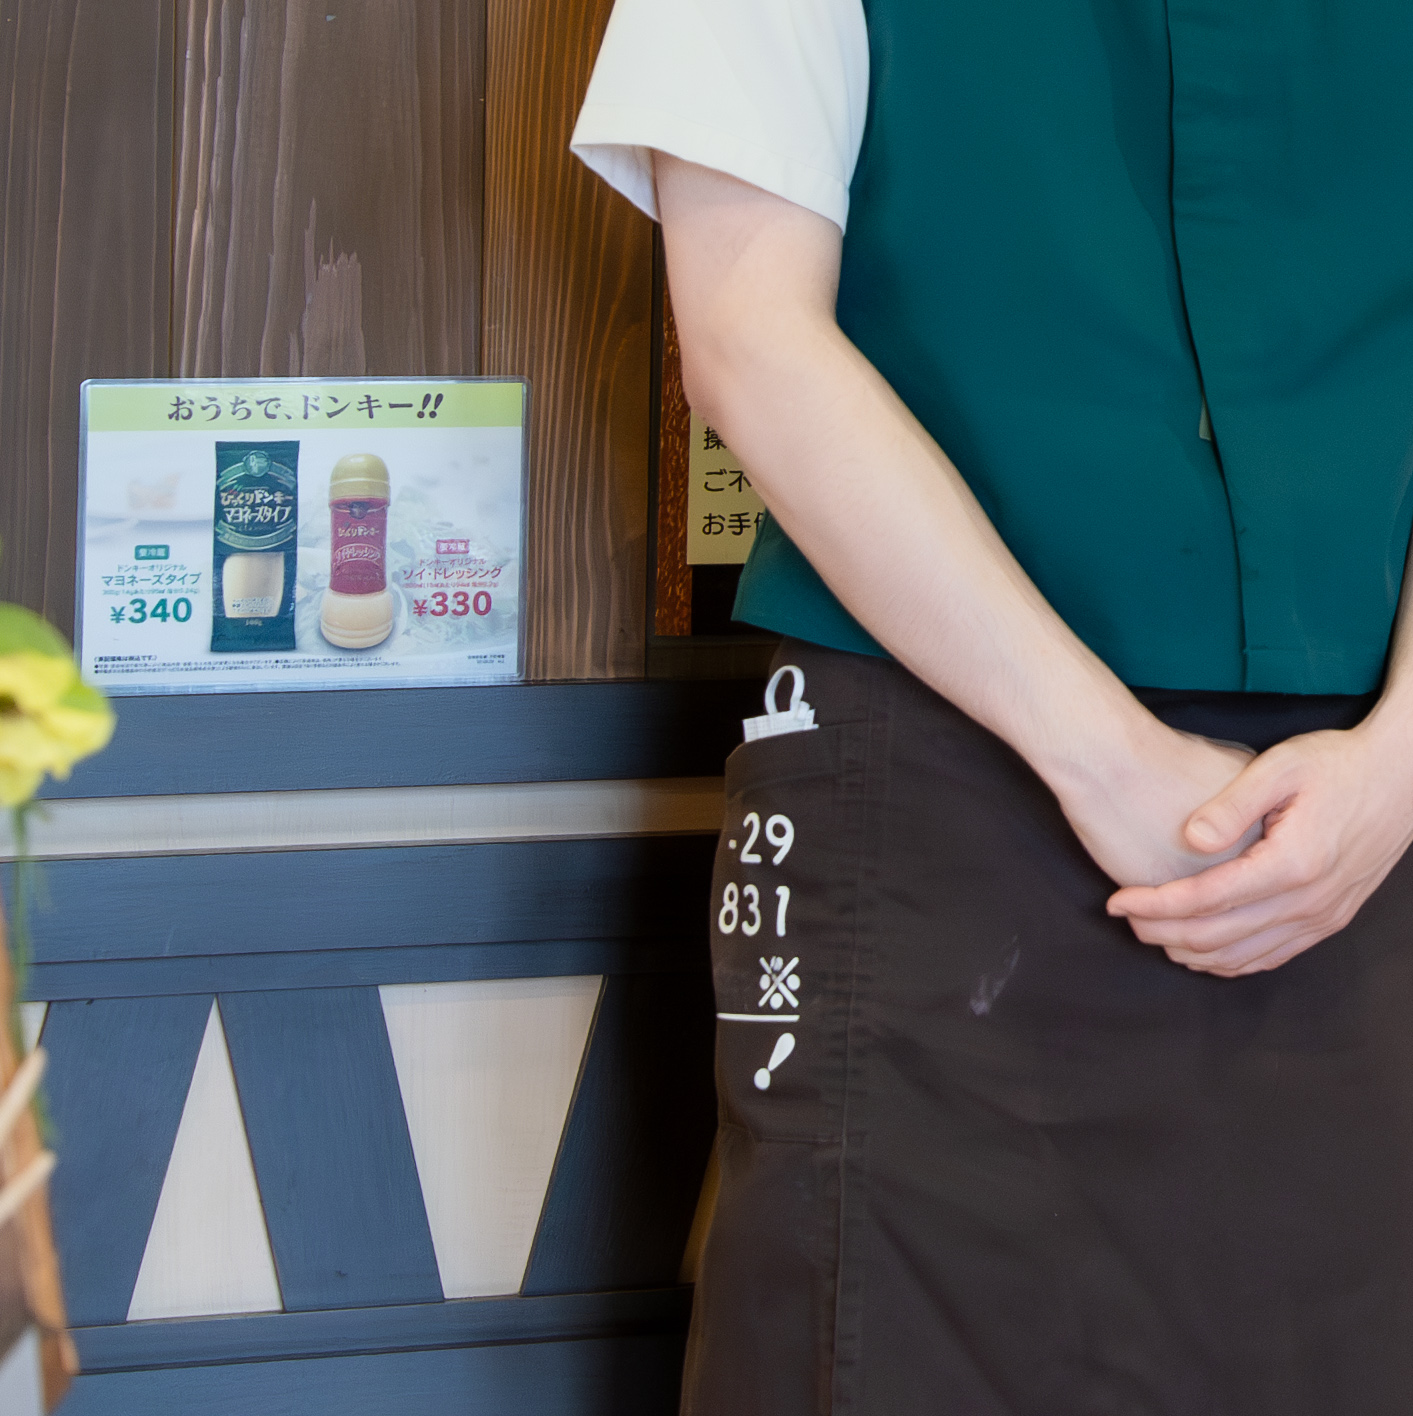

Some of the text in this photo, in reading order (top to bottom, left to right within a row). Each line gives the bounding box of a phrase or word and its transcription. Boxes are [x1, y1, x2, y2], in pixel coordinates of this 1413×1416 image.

[220, 489, 293, 506] びっくりドンキー
[223, 505, 292, 523] マヨネーズタイプ
[101, 572, 202, 586] マヨネーズタイプ
[110, 597, 192, 624] ¥340
[412, 590, 492, 617] ¥330
